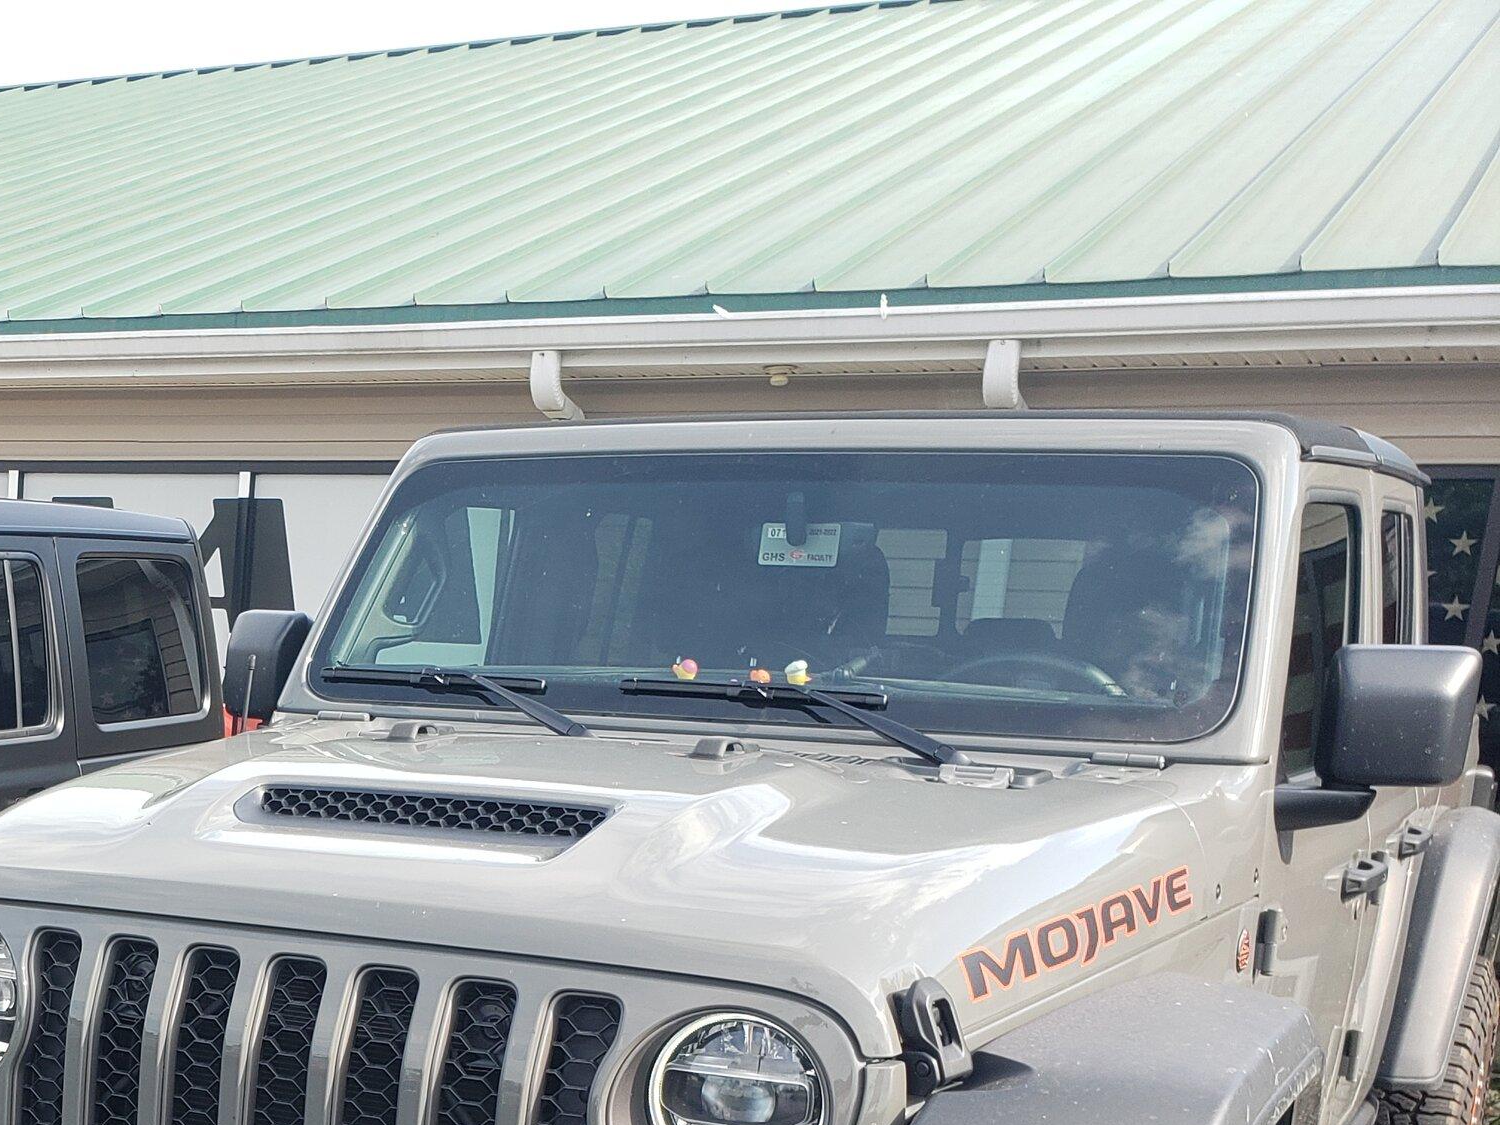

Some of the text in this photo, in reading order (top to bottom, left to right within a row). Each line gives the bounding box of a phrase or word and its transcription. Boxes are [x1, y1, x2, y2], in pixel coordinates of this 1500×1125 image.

[762, 552, 785, 562] GHS
[806, 553, 833, 562] FACULTY
[958, 864, 1193, 1001] MOJAVE
